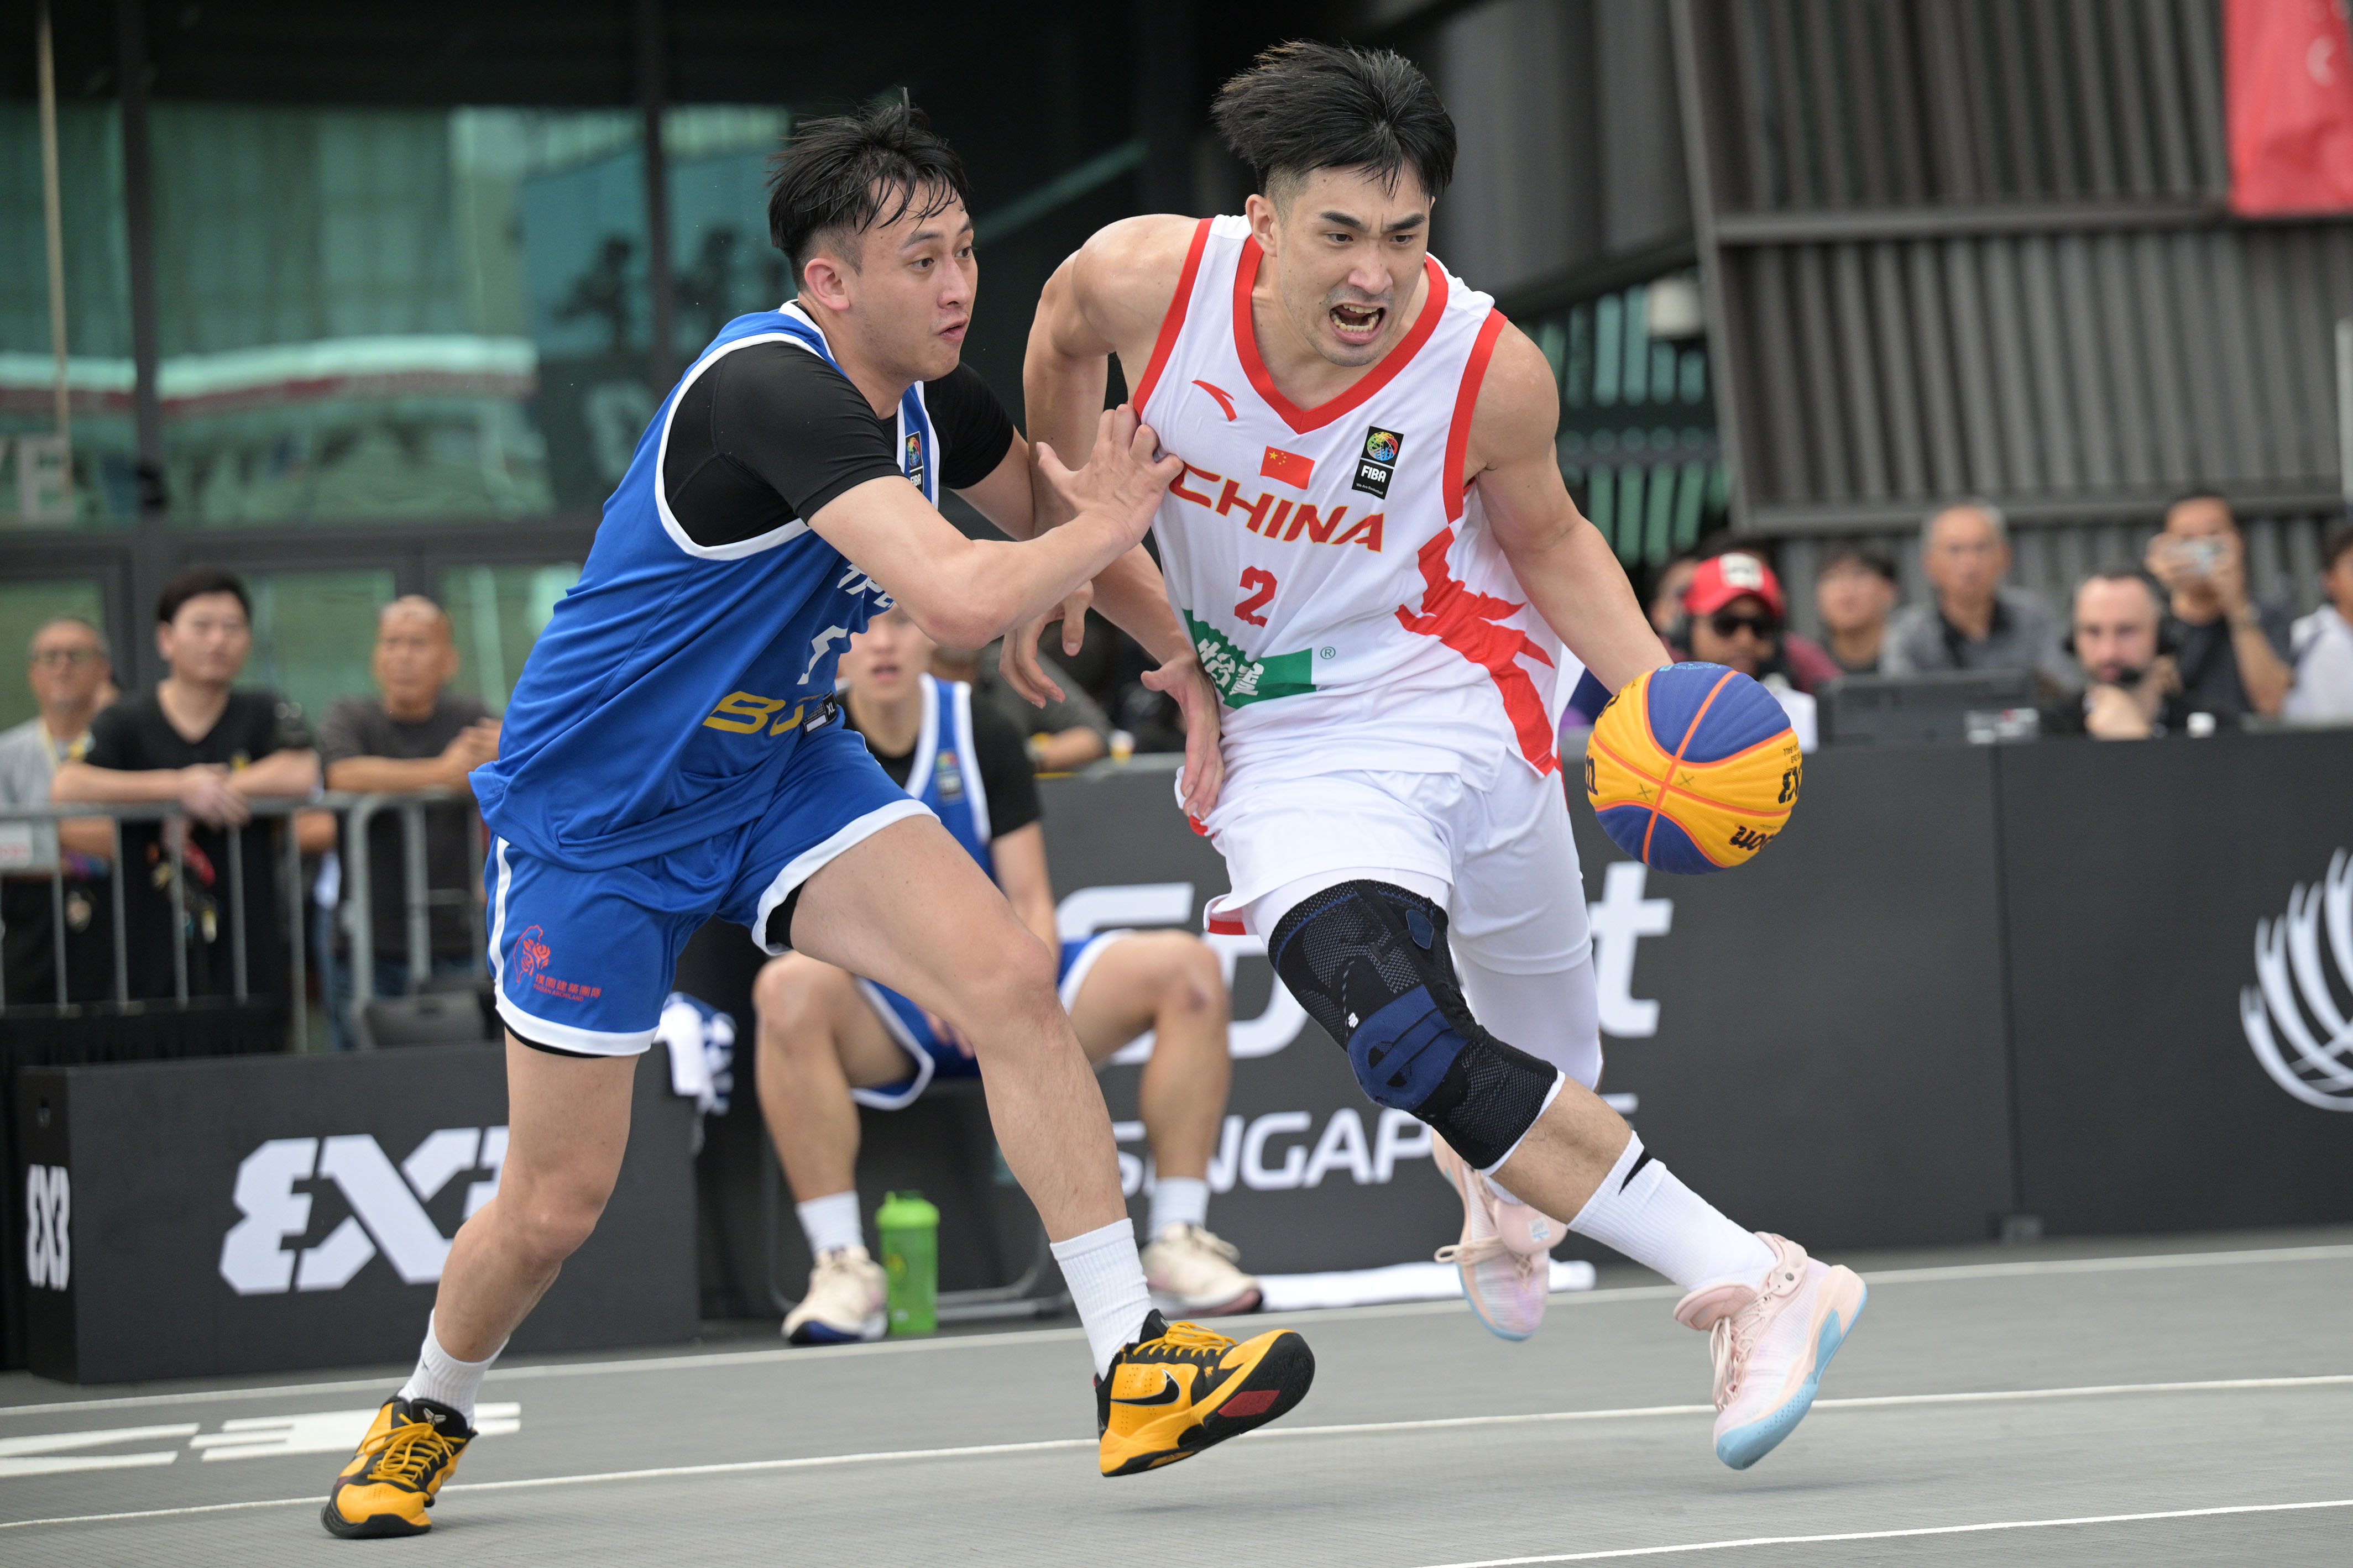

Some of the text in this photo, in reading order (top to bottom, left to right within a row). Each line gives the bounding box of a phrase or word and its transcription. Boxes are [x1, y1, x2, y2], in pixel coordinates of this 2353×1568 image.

[1361, 465, 1387, 483] FIBA
[1169, 463, 1384, 553] CHINA
[1234, 565, 1278, 628] 2
[826, 701, 835, 716] XL
